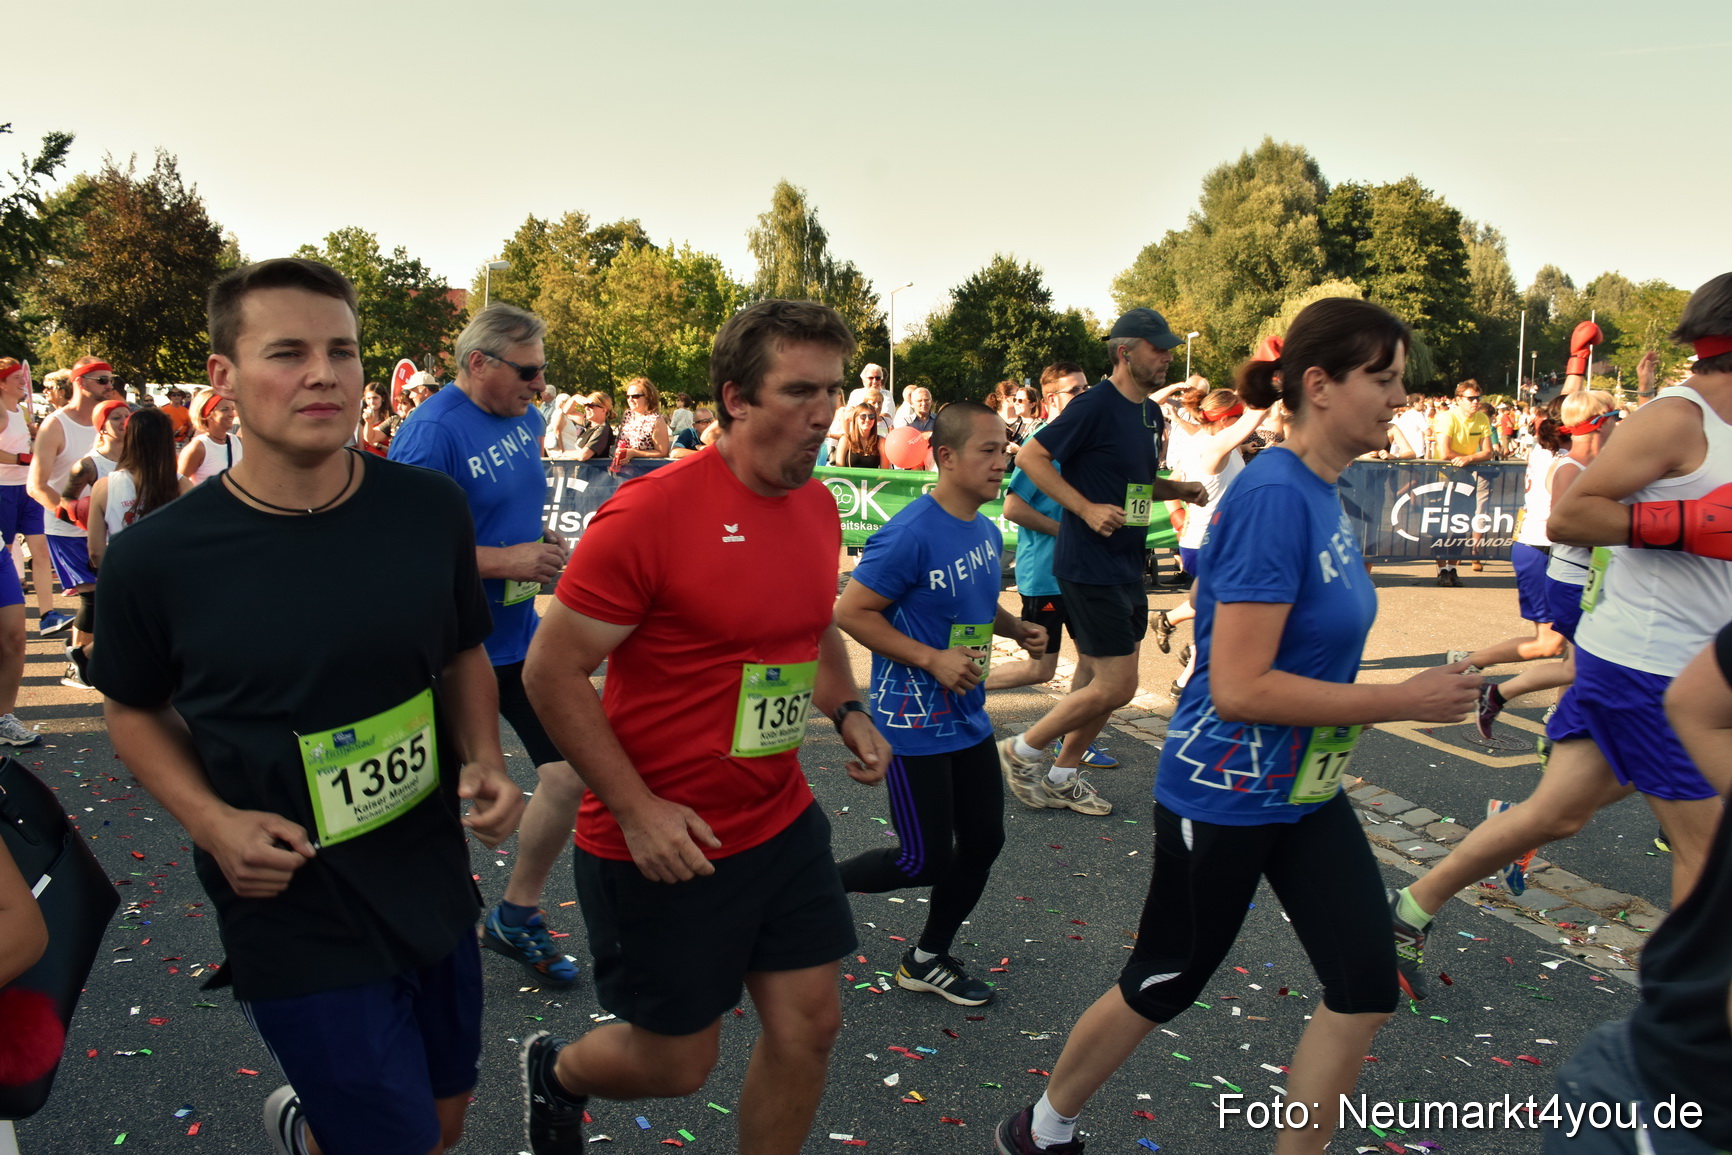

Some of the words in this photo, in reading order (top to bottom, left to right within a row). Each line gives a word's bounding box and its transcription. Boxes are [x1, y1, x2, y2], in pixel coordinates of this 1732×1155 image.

[1420, 507, 1514, 534] Fisch
[754, 692, 811, 730] 1367
[331, 732, 427, 806] 1365
